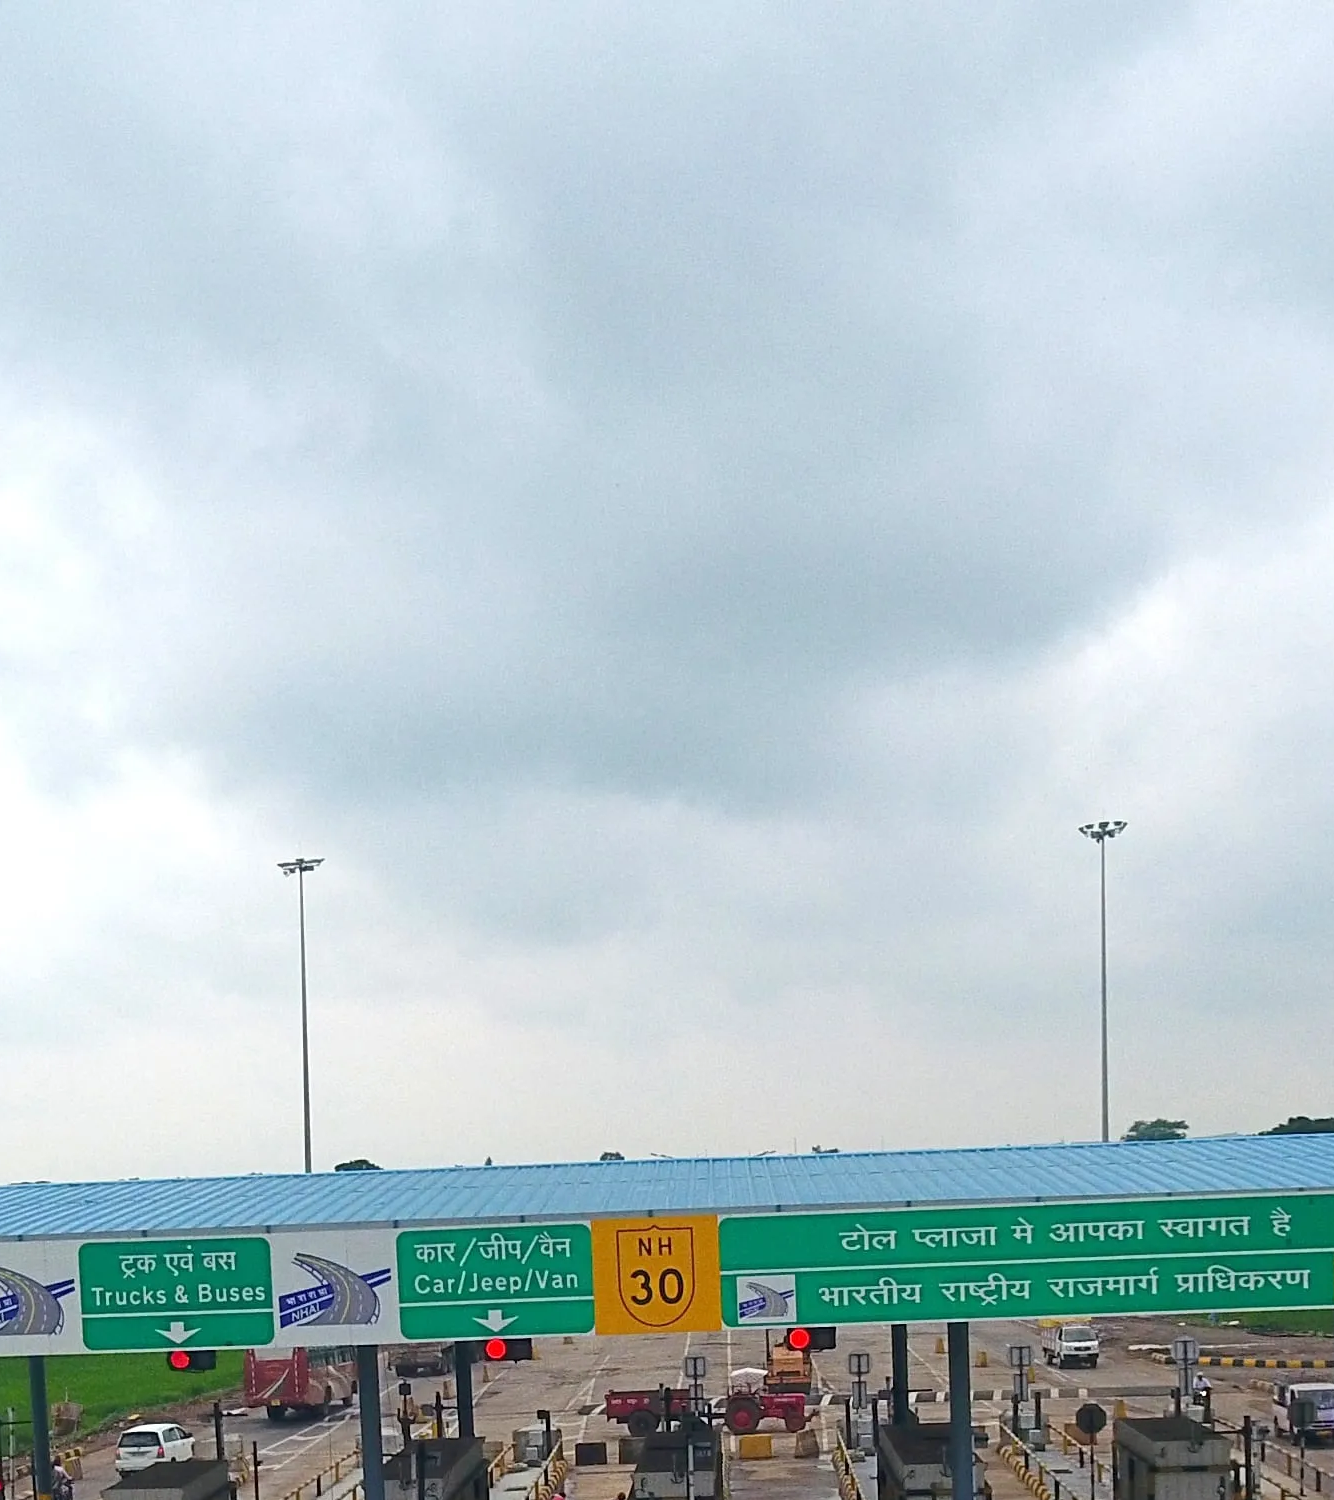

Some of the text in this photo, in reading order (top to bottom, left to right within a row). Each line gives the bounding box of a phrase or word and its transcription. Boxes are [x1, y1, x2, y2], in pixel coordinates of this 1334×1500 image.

[838, 1206, 1292, 1251] टोल प्लाजा मे आपका स्वागत है
[118, 1244, 236, 1279] ट्रक एवं बस
[638, 1237, 672, 1257] NH
[91, 1283, 266, 1306] Trucks & Buses
[630, 1268, 684, 1306] 30
[818, 1264, 1311, 1307] भारतीय राष्ट्रीय राजमार्ग प्राधिकरण
[291, 1303, 320, 1322] NHAI
